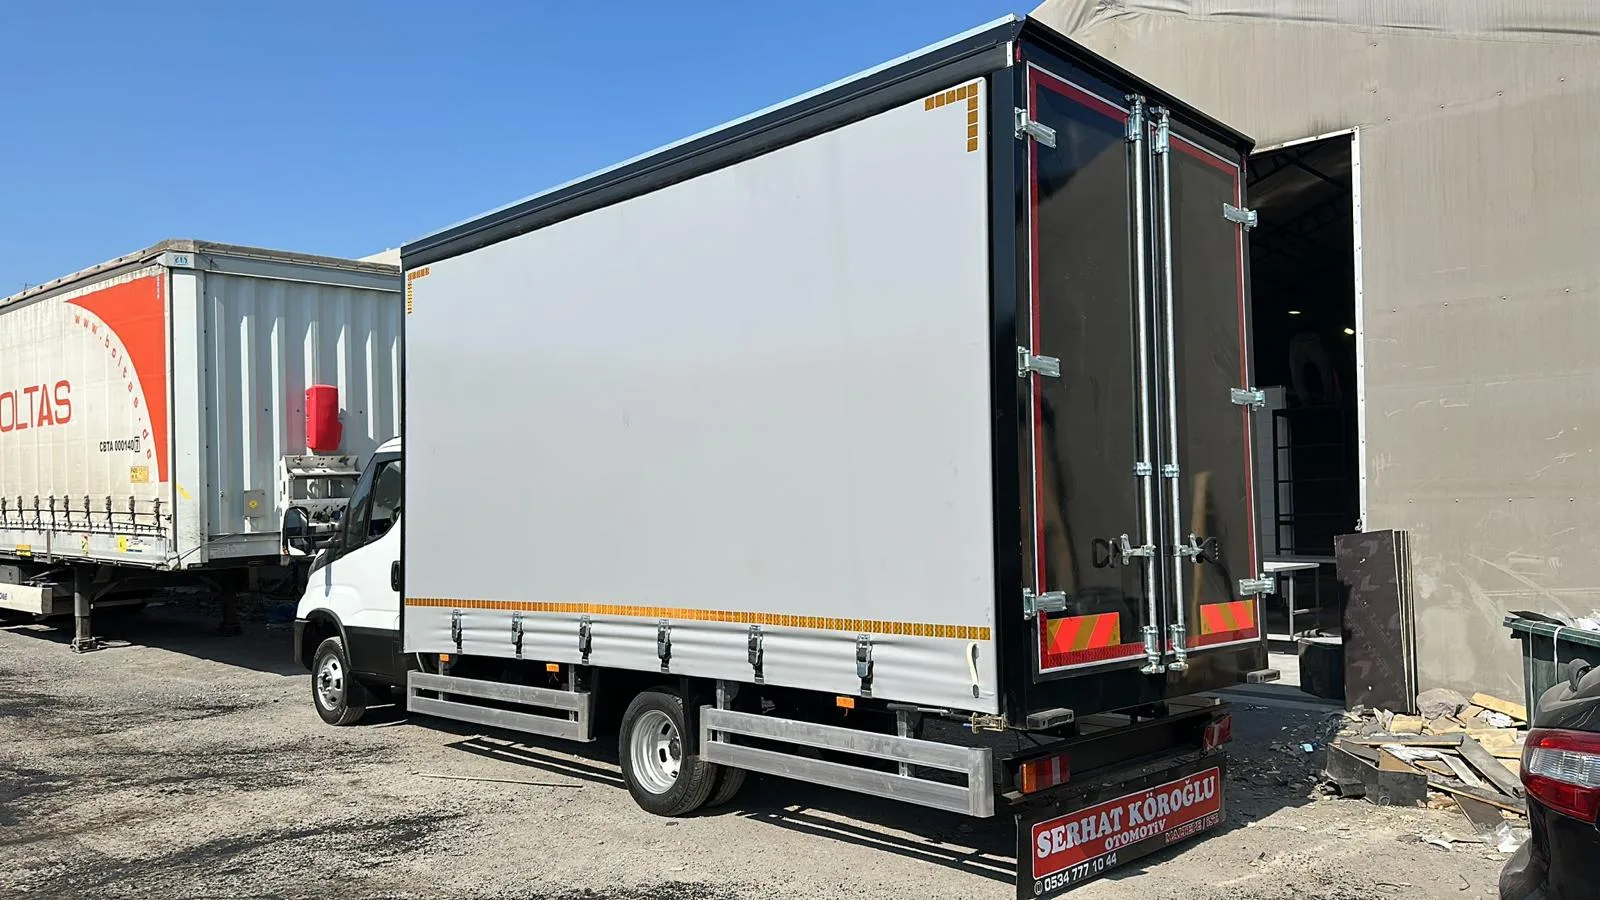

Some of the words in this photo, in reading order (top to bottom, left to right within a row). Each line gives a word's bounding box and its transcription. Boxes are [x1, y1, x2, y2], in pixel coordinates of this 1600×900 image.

[0, 380, 71, 432] OLTAS
[99, 440, 114, 452] CBTA
[1037, 807, 1123, 859] SERHAT
[1128, 776, 1215, 827] KÖROĞLU
[1044, 873, 1070, 892] 0534
[1071, 863, 1089, 881] 777
[1092, 858, 1104, 872] 10
[1106, 853, 1117, 866] 44
